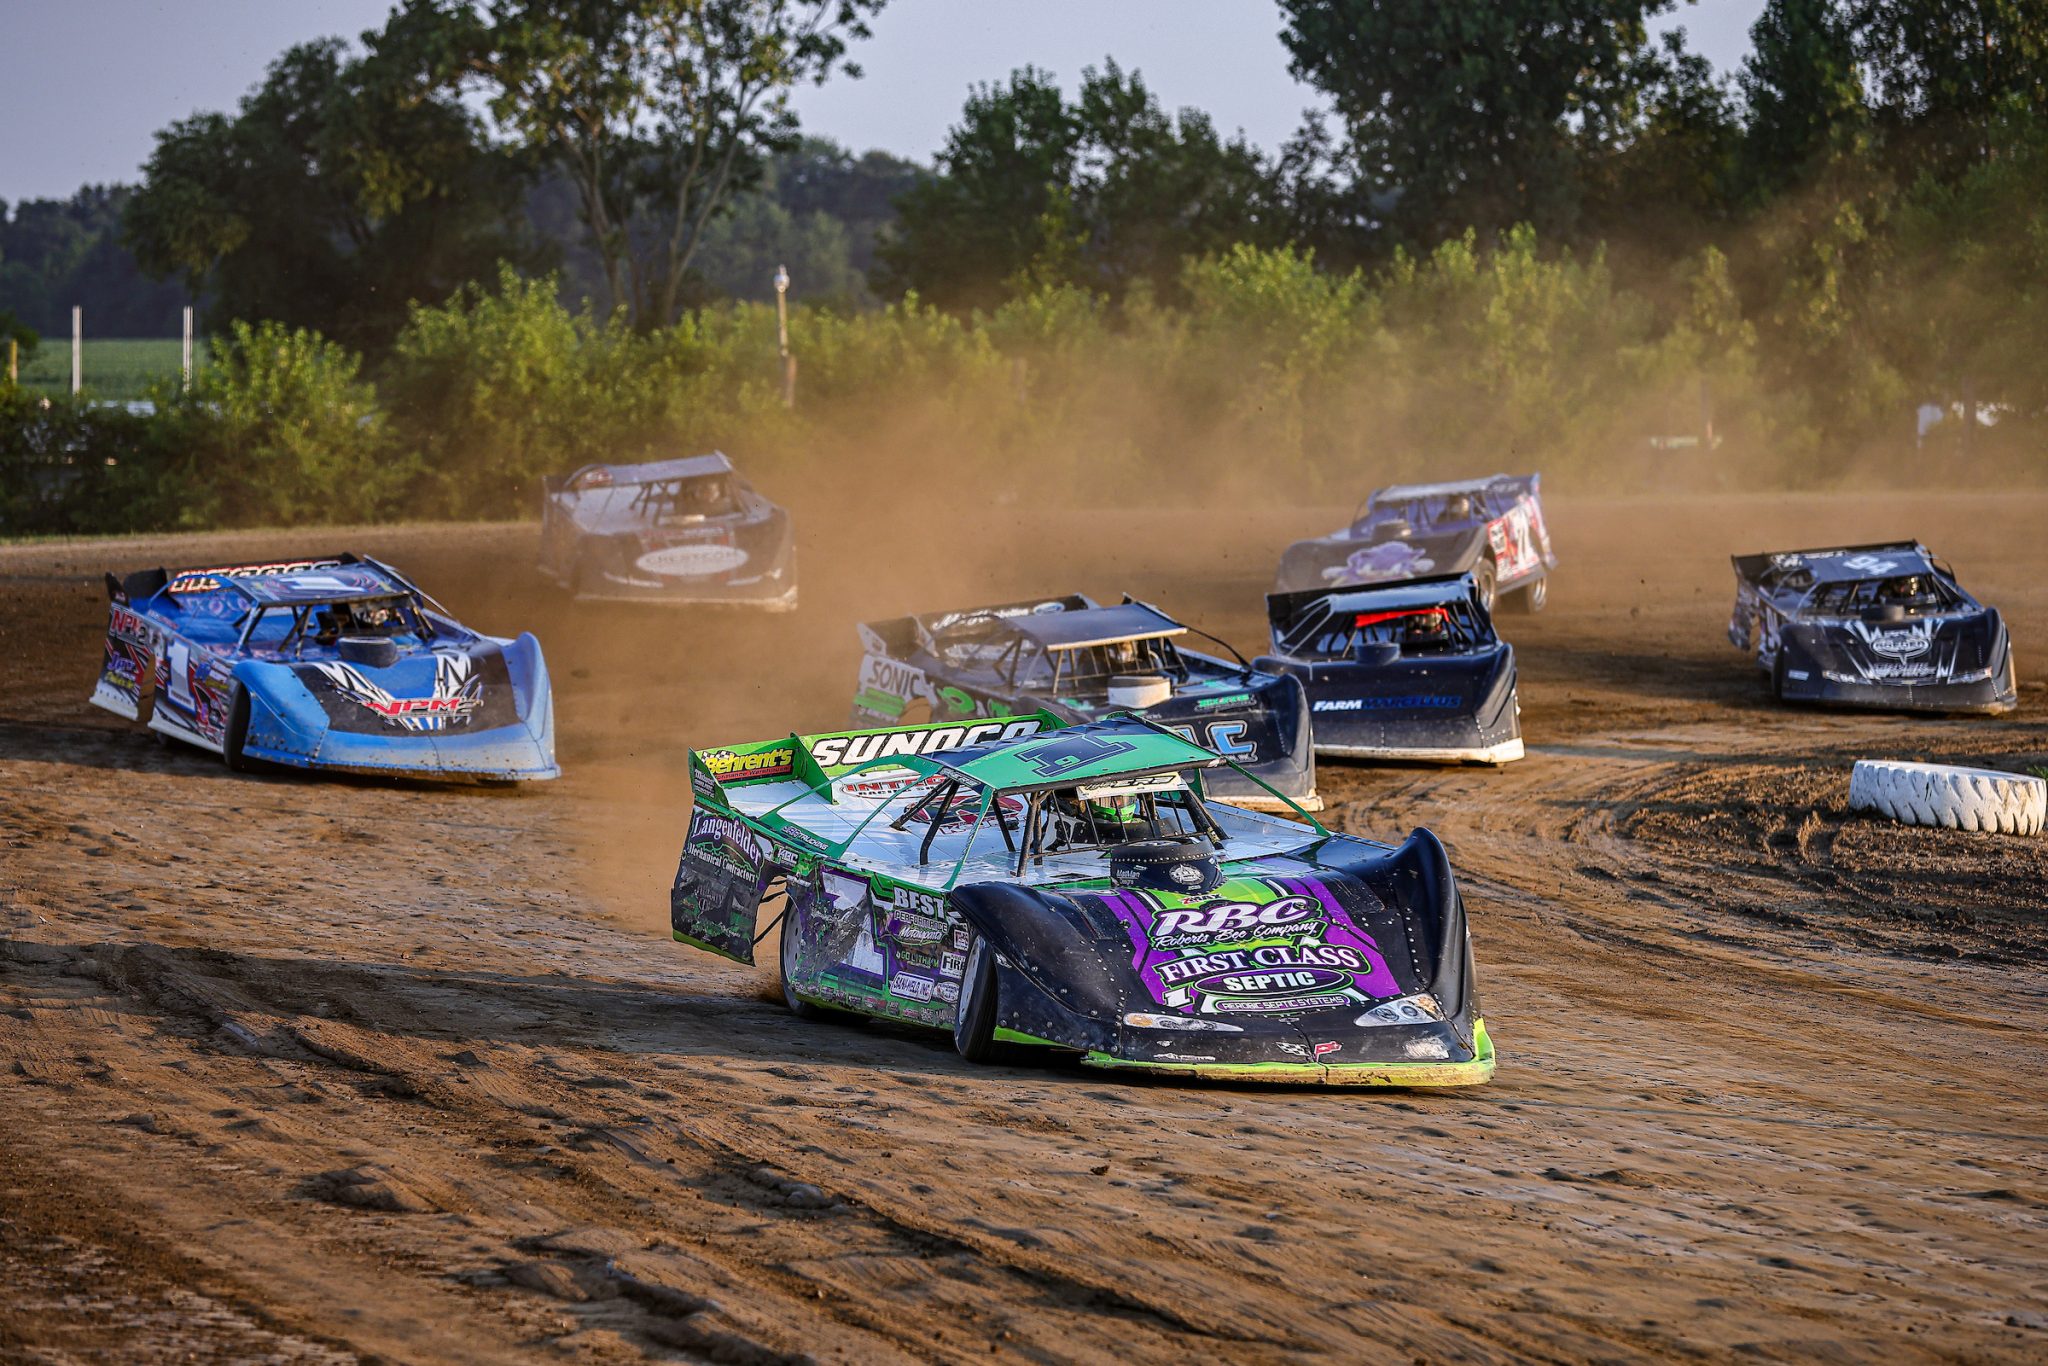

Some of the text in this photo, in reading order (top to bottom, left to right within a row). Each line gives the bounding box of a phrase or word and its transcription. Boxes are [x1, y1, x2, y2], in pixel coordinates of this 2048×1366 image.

[167, 640, 196, 713] 1
[867, 660, 921, 699] SONIC
[1312, 700, 1363, 712] FARM
[705, 748, 793, 774] Behrent's
[811, 720, 1041, 767] SUNOCO
[691, 817, 763, 866] Langenfelder
[688, 842, 756, 883] Mechanical Contractors
[894, 910, 948, 933] PERFORMANCE
[1154, 920, 1318, 949] Roberts Bee Company
[1156, 898, 1312, 937] RBC
[1160, 946, 1362, 984] FIRST CLASS
[1222, 970, 1317, 993] SEPTIC
[1265, 998, 1300, 1010] SEPTIC
[1301, 995, 1345, 1008] SYSTEMS
